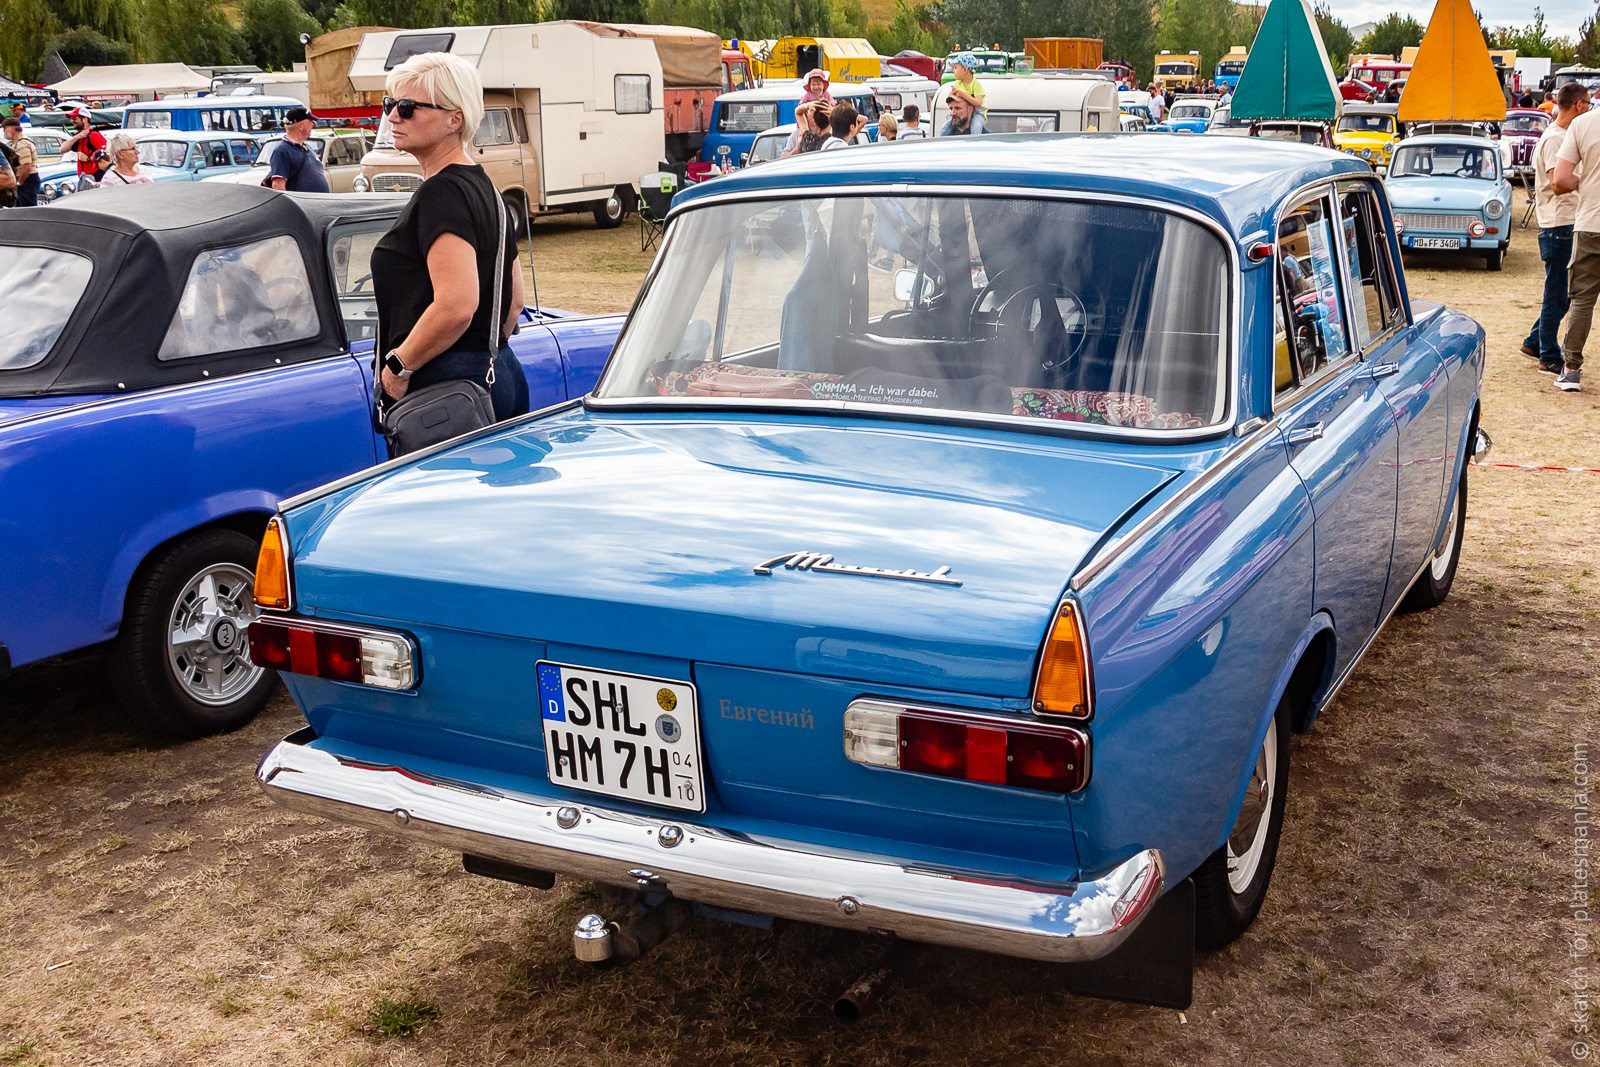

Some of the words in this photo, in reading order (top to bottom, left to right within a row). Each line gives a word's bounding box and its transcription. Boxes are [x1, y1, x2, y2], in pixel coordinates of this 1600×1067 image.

[719, 147, 729, 155] DDR
[661, 176, 672, 193] 6
[1414, 238, 1424, 247] MD
[1429, 239, 1438, 247] FF
[813, 382, 856, 393] OMMMA
[869, 384, 884, 395] Ich
[887, 388, 906, 396] war
[908, 387, 939, 398] dabei.
[548, 699, 559, 715] D
[565, 676, 647, 737] SHL
[718, 698, 815, 731] Евгений
[550, 729, 605, 786] HM
[613, 739, 672, 799] 7H
[672, 751, 692, 768] 04
[677, 785, 695, 801] 10
